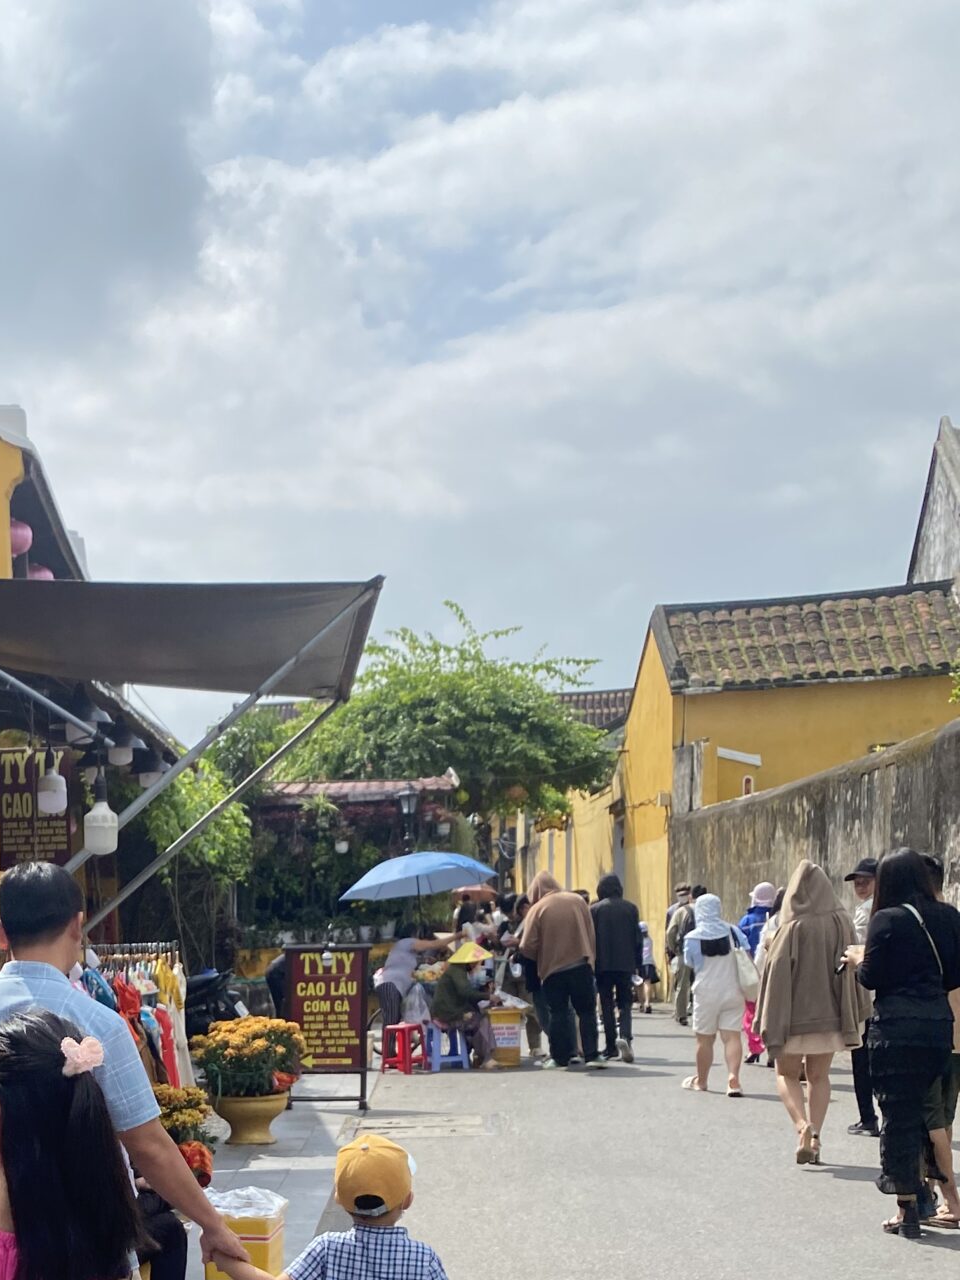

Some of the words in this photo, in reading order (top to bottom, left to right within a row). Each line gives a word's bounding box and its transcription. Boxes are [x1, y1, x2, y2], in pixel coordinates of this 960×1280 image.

[1, 752, 30, 785] TY
[2, 792, 32, 819] CAO
[297, 982, 326, 997] CAO
[303, 1000, 331, 1013] CƠM
[334, 997, 350, 1012] GÀ
